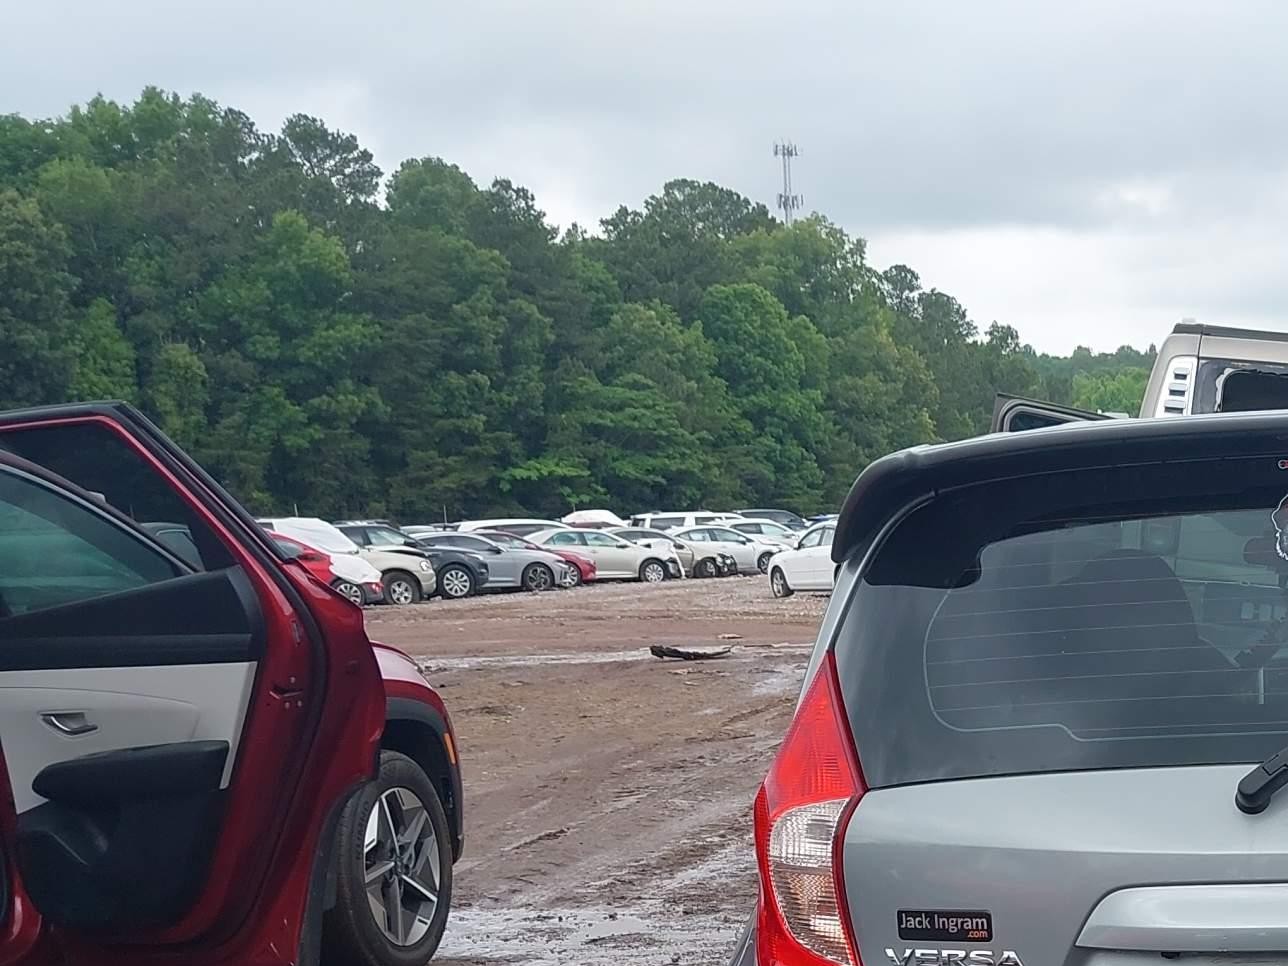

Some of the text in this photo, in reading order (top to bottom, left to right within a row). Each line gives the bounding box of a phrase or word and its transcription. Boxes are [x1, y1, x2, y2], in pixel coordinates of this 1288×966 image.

[900, 912, 988, 933] Jack Ingram
[967, 930, 988, 938] .com
